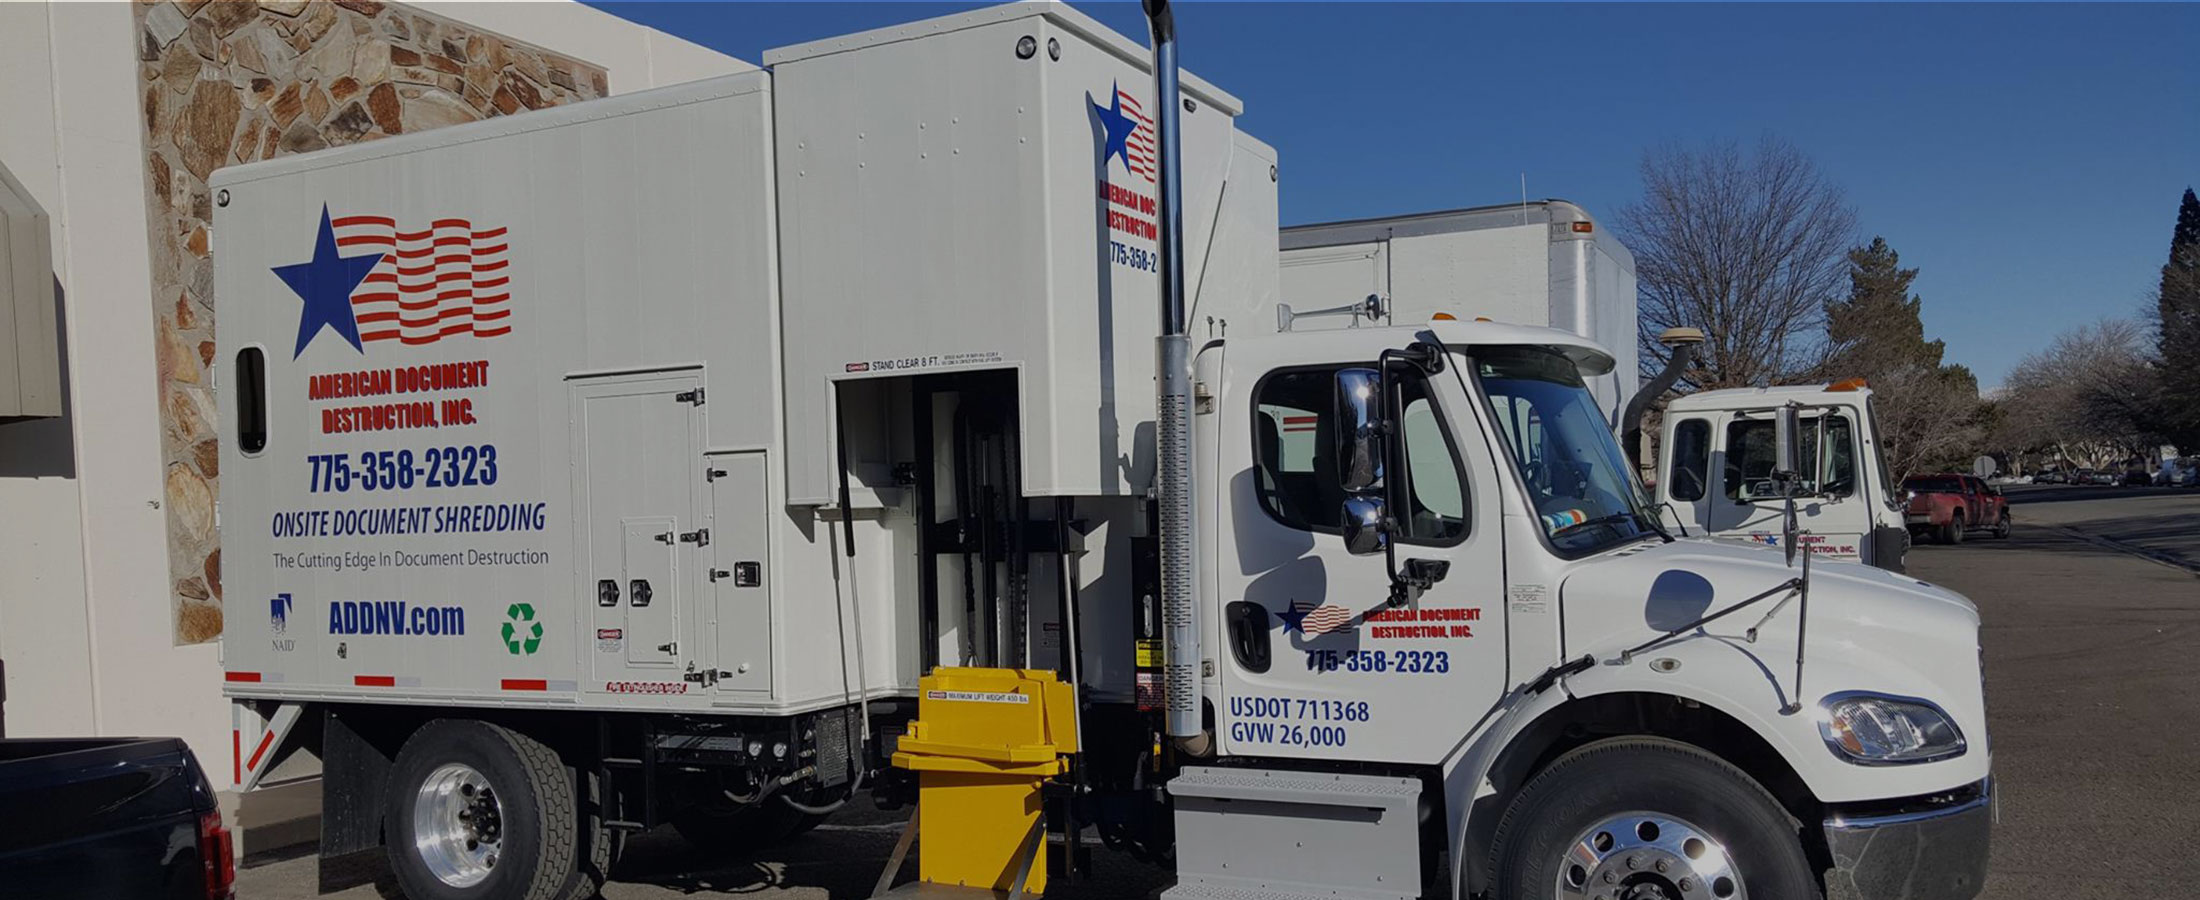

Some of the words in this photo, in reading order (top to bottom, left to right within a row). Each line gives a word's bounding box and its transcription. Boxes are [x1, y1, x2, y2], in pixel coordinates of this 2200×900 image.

[1099, 180, 1138, 211] AMERICAN
[1139, 195, 1156, 217] DOC
[1110, 240, 1157, 273] 775-358-2
[872, 360, 894, 371] STAND
[896, 358, 919, 369] CLEAR
[921, 356, 927, 367] 8
[928, 356, 940, 367] FT.
[308, 368, 392, 400] AMERICAN
[395, 360, 489, 393] DOCUMENT
[321, 400, 438, 434] DESTRUCTION,
[441, 398, 477, 425] INC.
[307, 444, 498, 493] 775-358-2323
[272, 510, 329, 537] ONSITE
[333, 506, 432, 536] DOCUMENT
[434, 503, 547, 533] SHREDDING
[1797, 536, 1826, 544] UMENT
[273, 553, 295, 568] The
[297, 552, 341, 572] Cutting
[345, 552, 376, 571] Edge
[380, 551, 391, 566] In
[395, 550, 464, 567] Document
[468, 548, 549, 566] Destruction
[329, 601, 465, 635] ADDNV.com
[1363, 608, 1419, 623] AMERICAN
[1419, 607, 1481, 622] DOCUMENT
[1372, 624, 1449, 639] DESTRUCTION,
[1450, 624, 1474, 638] INC.
[272, 639, 295, 652] NAID
[1305, 650, 1449, 674] 775-358-2323
[1230, 697, 1291, 720] USDOT
[1297, 699, 1370, 722] 711368
[1231, 722, 1275, 744] GVW
[1279, 724, 1346, 748] 26,000
